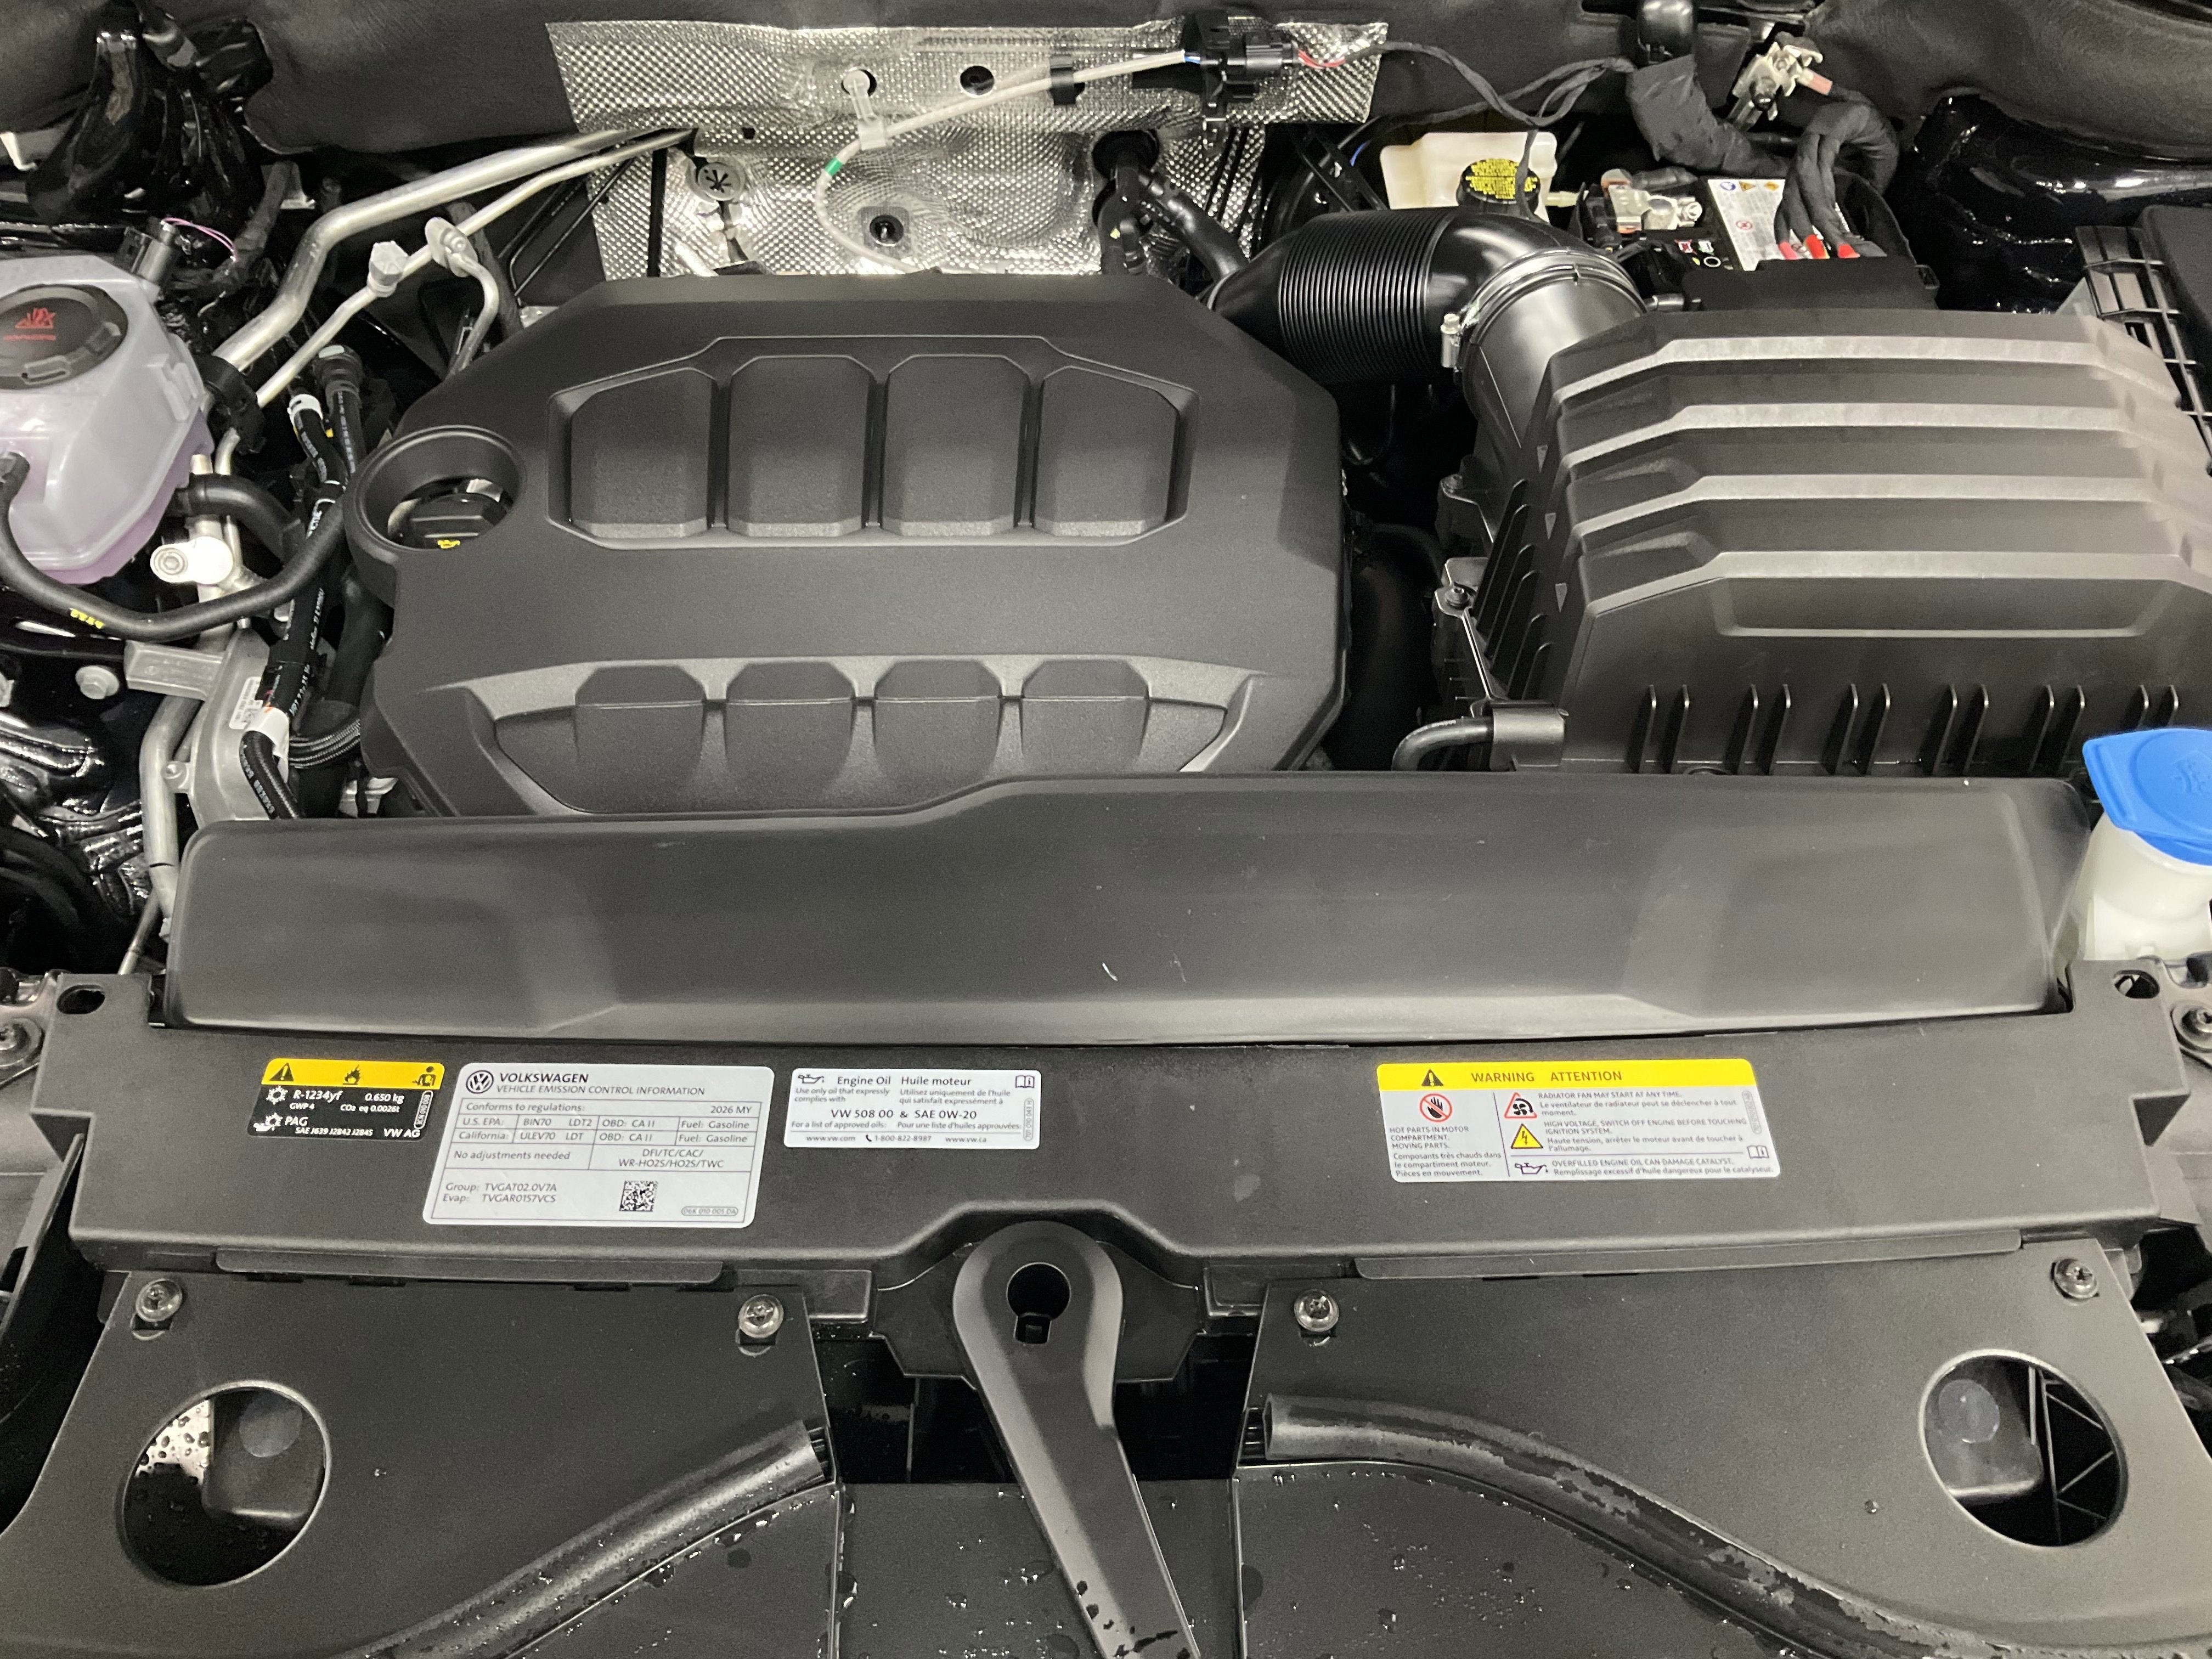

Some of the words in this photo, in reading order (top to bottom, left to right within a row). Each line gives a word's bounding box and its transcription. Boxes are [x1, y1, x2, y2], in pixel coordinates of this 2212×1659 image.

[500, 1073, 589, 1083] VOLKSWAGEN
[837, 1076, 873, 1087] Engine
[876, 1076, 890, 1085] Oil
[901, 1076, 929, 1085] Huile
[1471, 1071, 1534, 1082] WARNING
[1550, 1071, 1622, 1082] ATTENTION
[293, 1091, 343, 1102] R-1234yf
[365, 1093, 391, 1102] 0.650
[393, 1094, 404, 1104] kg
[945, 1097, 996, 1105] expressément
[528, 1103, 585, 1113] regulations:
[831, 1109, 851, 1118] VW
[915, 1110, 935, 1118] SAE
[939, 1110, 977, 1119] 0W-20
[285, 1116, 308, 1126] PAG
[404, 1129, 420, 1138] AG
[470, 1152, 531, 1161] adjustments
[643, 1149, 704, 1157] DFI/TC/CAC/
[619, 1159, 724, 1167] WR-HO2S/HO2S/TWC
[446, 1183, 479, 1192] Group:
[443, 1194, 469, 1204] Evap:
